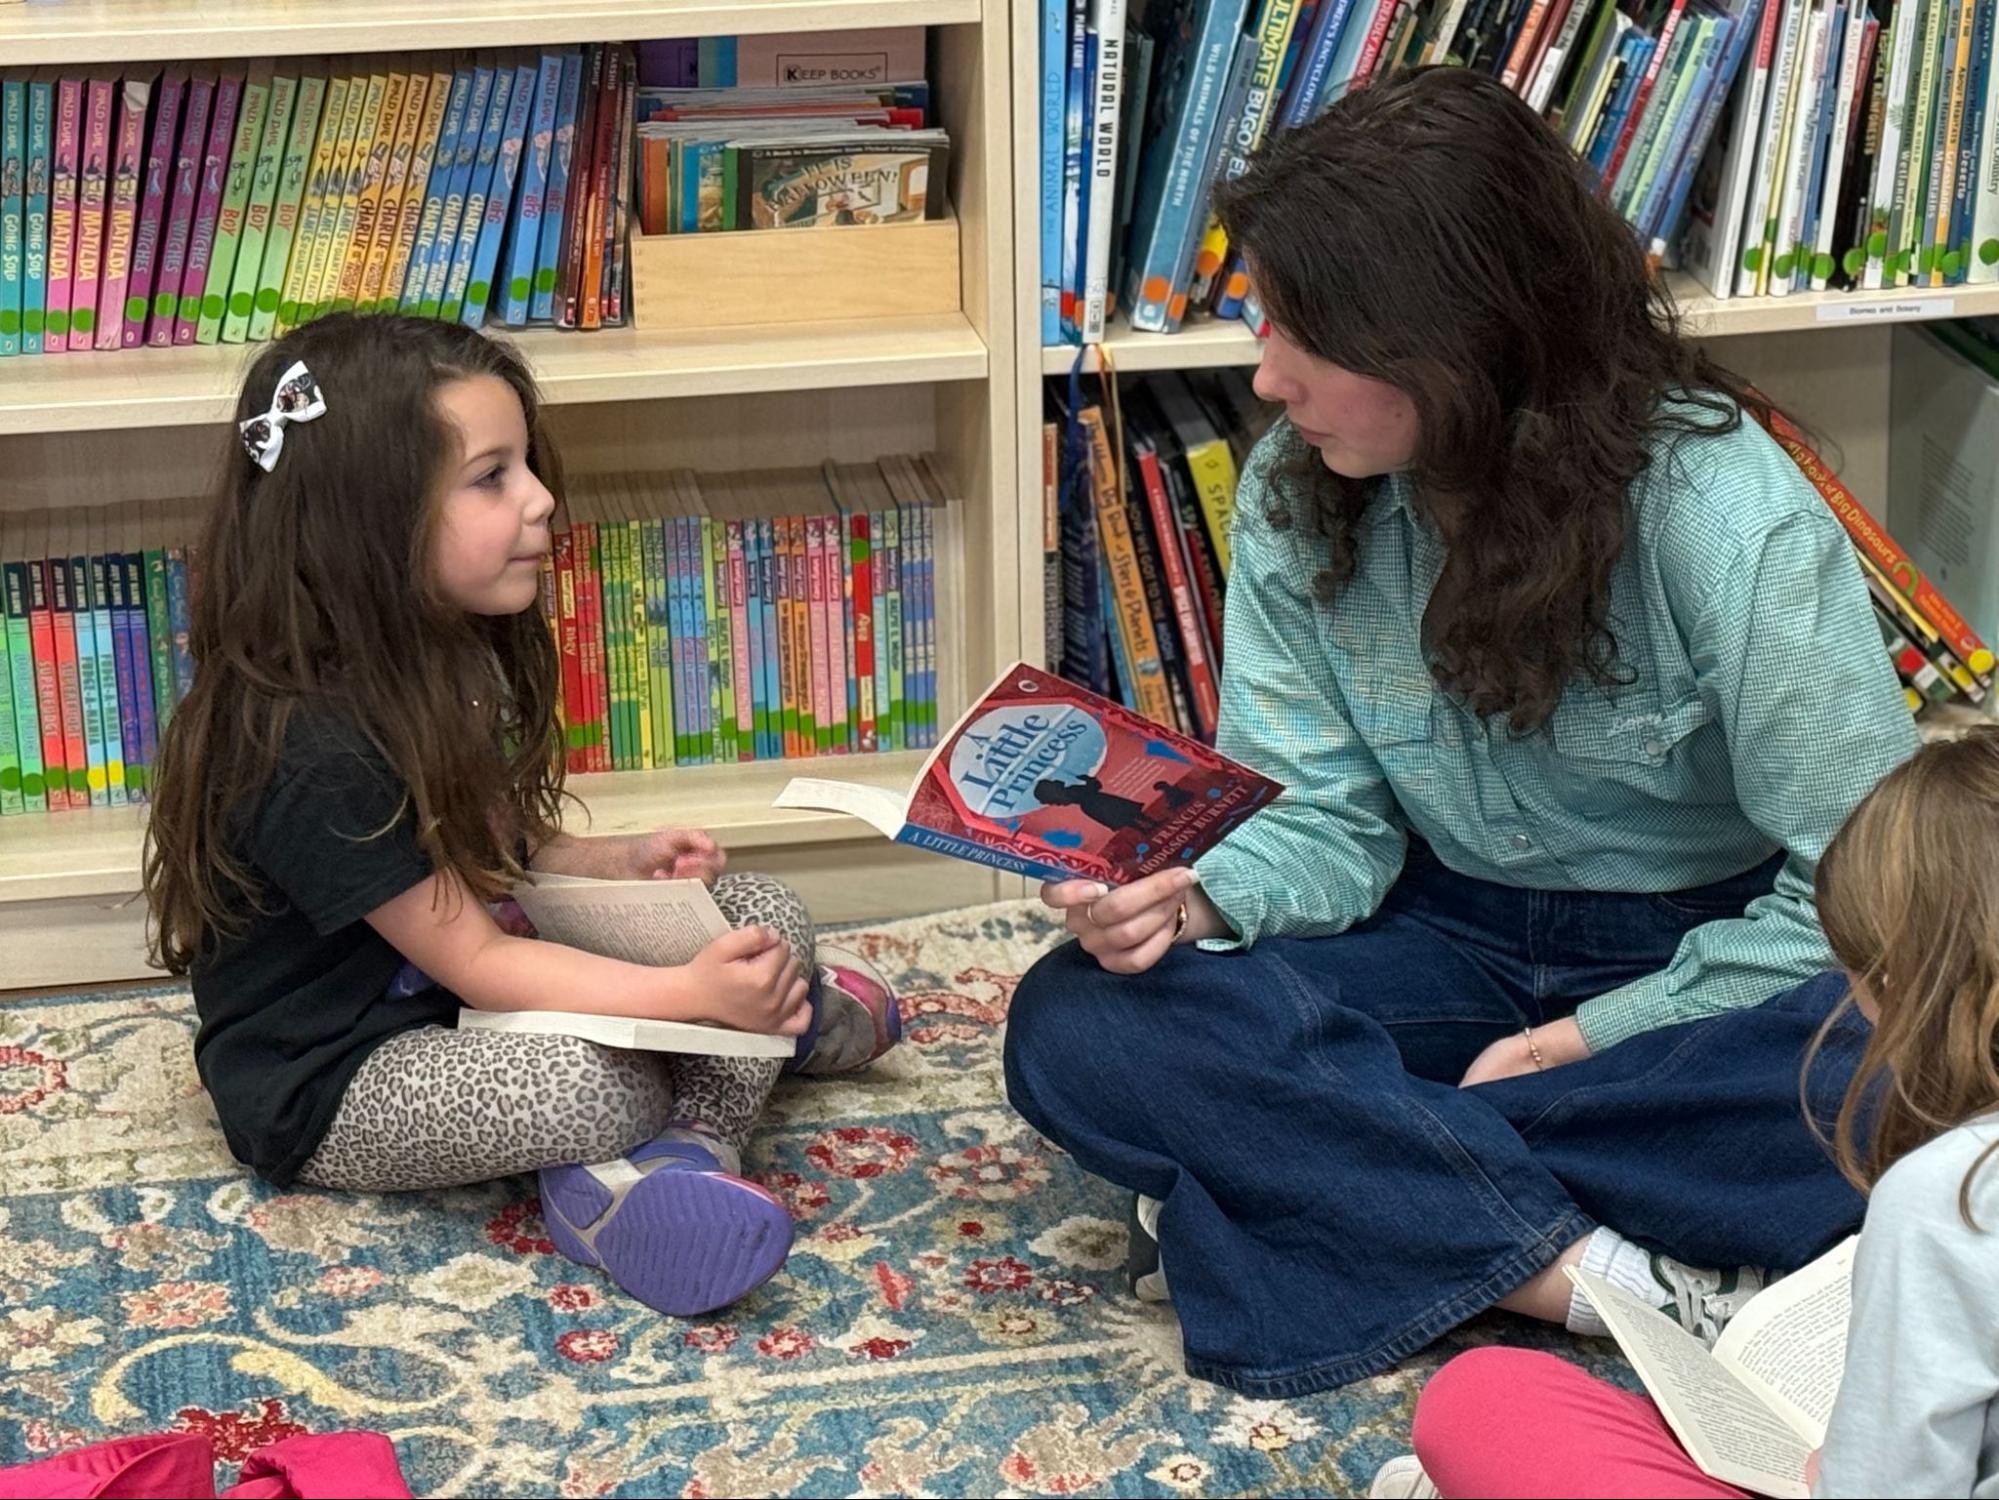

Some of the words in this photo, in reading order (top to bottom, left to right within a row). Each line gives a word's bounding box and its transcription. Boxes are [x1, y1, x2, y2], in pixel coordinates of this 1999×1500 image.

[1369, 1, 1393, 43] DEADLY
[1785, 10, 1800, 49] TREES
[606, 51, 618, 91] TARSHIS
[786, 66, 826, 81] KEEP
[831, 68, 876, 81] BOOKS
[1099, 38, 1118, 114] NATURAL
[1205, 41, 1222, 73] WILD
[1779, 50, 1793, 82] HAVE
[1044, 71, 1063, 136] WORLD
[1191, 74, 1214, 126] ANIMALS
[1770, 84, 1787, 131] LEAVES
[1863, 80, 1883, 156] RAINFORESTS
[1095, 122, 1113, 178] WORLD
[1187, 126, 1200, 142] OF
[1912, 129, 1922, 163] WORLD
[834, 158, 852, 171] IS
[1180, 144, 1195, 167] THE
[1956, 149, 1971, 200] Deserts
[1041, 149, 1060, 211] ANIMAL
[1170, 167, 1190, 207] NORTH
[1893, 149, 1911, 211] Wetlands
[1927, 149, 1944, 219] Mountains
[1938, 150, 1955, 219] Grasslands
[221, 208, 240, 236] BOY
[248, 204, 268, 233] BOY
[276, 204, 296, 232] BOY
[315, 202, 338, 241] JAMES
[336, 202, 356, 240] JAMES
[351, 196, 376, 250] CHARLIE
[374, 197, 399, 250] CHARLIE
[396, 197, 422, 249] CHARLIE
[417, 195, 442, 247] CHARLIE
[437, 192, 462, 245] CHARLIE
[460, 191, 485, 244] CHARLIE
[486, 199, 506, 225] BFG
[522, 193, 540, 219] BFG
[4, 214, 19, 250] GOING
[29, 213, 44, 249] GOING
[50, 209, 72, 280] MATILDA
[79, 210, 101, 281] MATILDA
[108, 210, 132, 280] MATILDA
[134, 219, 156, 273] WITCHES
[165, 218, 187, 273] WITCHES
[190, 216, 214, 270] WITCHES
[3, 254, 19, 280] SOLO
[28, 253, 43, 279] SOLO
[1879, 305, 1892, 313] and
[1096, 486, 1118, 510] Big
[1127, 501, 1143, 533] HOW
[1135, 533, 1149, 556] WE
[1828, 489, 1853, 515] Big
[1845, 506, 1900, 566] Dinosaurs
[8, 572, 19, 589] JUDY
[1113, 552, 1136, 588] Stars
[1140, 556, 1155, 580] GOT
[11, 591, 22, 614] BLUME
[1146, 581, 1159, 598] TO
[1150, 598, 1165, 621] THE
[1173, 584, 1190, 612] SPACE
[561, 626, 576, 656] Ribsy
[856, 612, 871, 641] Ribsy
[1124, 600, 1151, 653] Planets
[1155, 620, 1175, 660] MOON
[38, 658, 58, 737] SUPERFUDGE
[60, 661, 82, 739] SUPERFUDGE
[81, 655, 100, 745] FUDGE-A-MANIA
[99, 653, 120, 742] FUDGE-A-MANIA
[961, 712, 1050, 791] Little
[974, 733, 988, 748] A
[990, 719, 1088, 812] Princess
[1139, 826, 1199, 876] HODGSON
[1194, 786, 1249, 836] BURNETT
[1153, 801, 1207, 848] FRANCES
[909, 832, 920, 844] A
[923, 834, 970, 860] LITTLE
[969, 846, 1030, 872] PRINCESS
